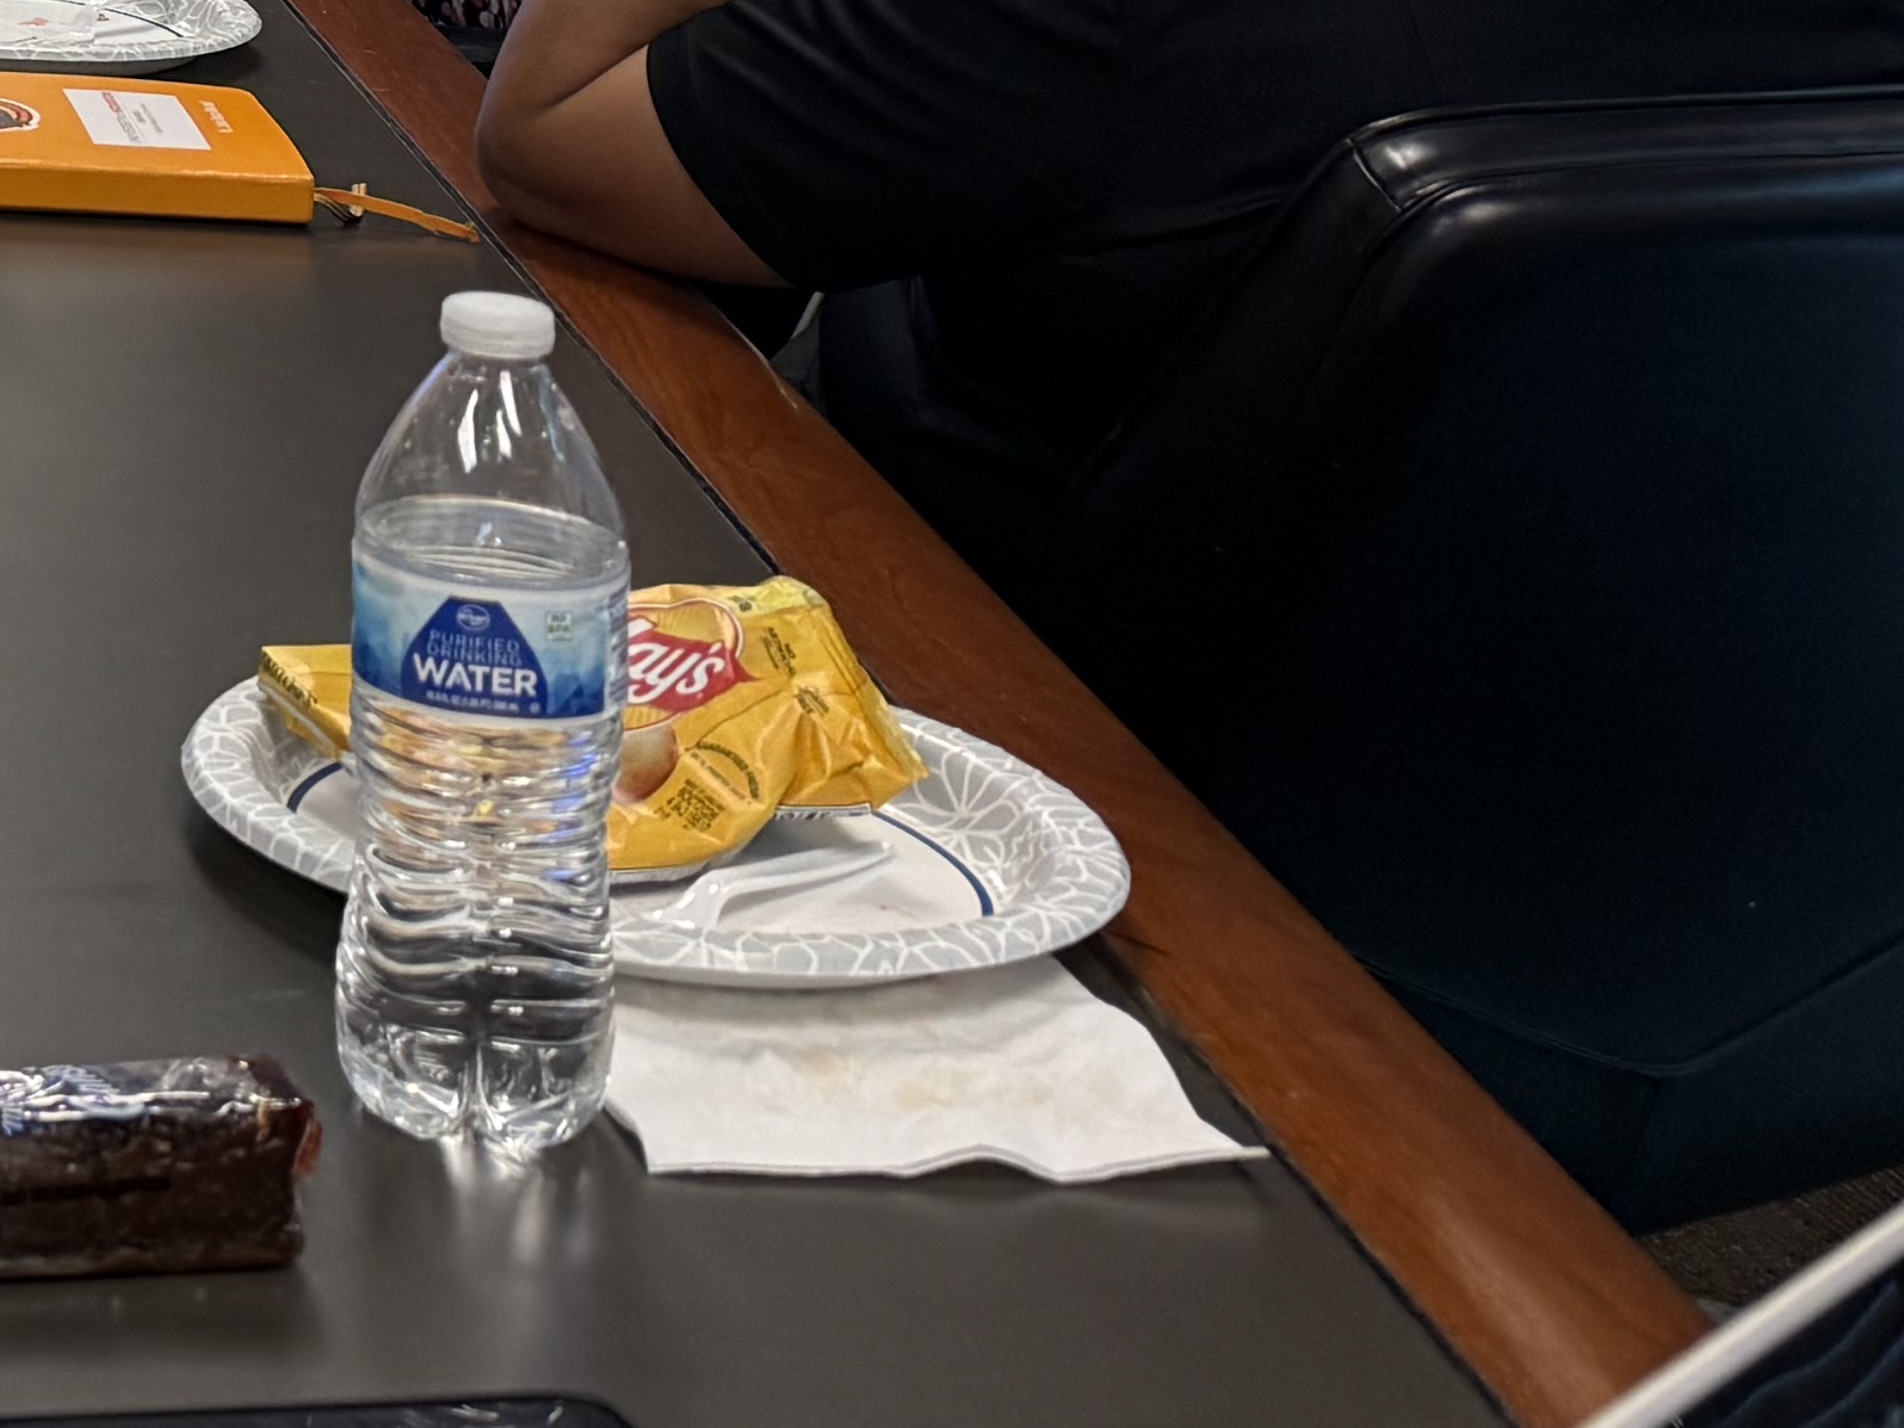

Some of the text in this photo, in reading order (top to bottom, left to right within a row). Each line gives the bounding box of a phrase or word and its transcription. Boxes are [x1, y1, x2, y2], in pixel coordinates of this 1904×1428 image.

[426, 645, 522, 666] DRINKING
[429, 629, 520, 652] PURIFIED
[413, 653, 537, 696] WATER
[627, 616, 725, 704] ay's
